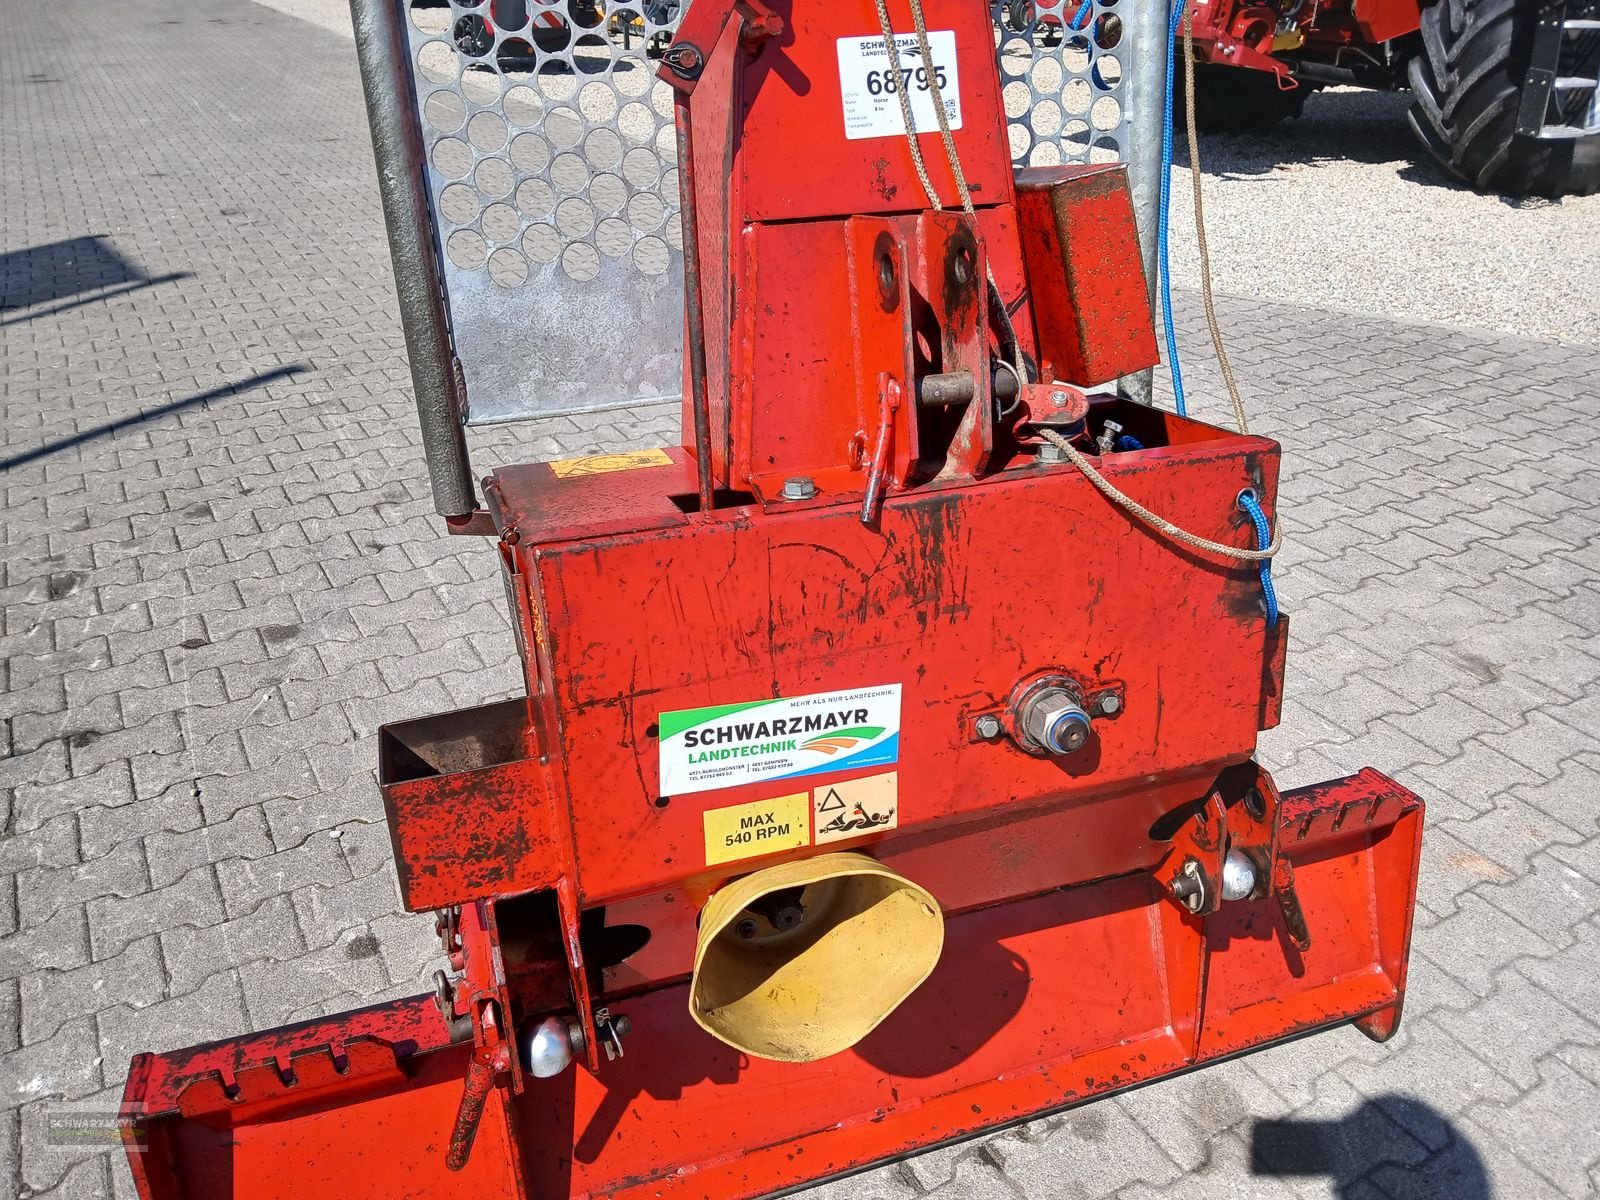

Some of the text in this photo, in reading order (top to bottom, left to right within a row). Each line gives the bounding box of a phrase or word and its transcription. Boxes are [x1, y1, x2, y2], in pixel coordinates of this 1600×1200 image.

[866, 66, 947, 95] 68795
[845, 690, 895, 700] LANDTECHNIK.
[684, 708, 868, 748] SCHWARZMAYR
[688, 740, 796, 764] LANDTECHNIK
[740, 812, 775, 830] MAX
[725, 824, 790, 847] 540 RPM
